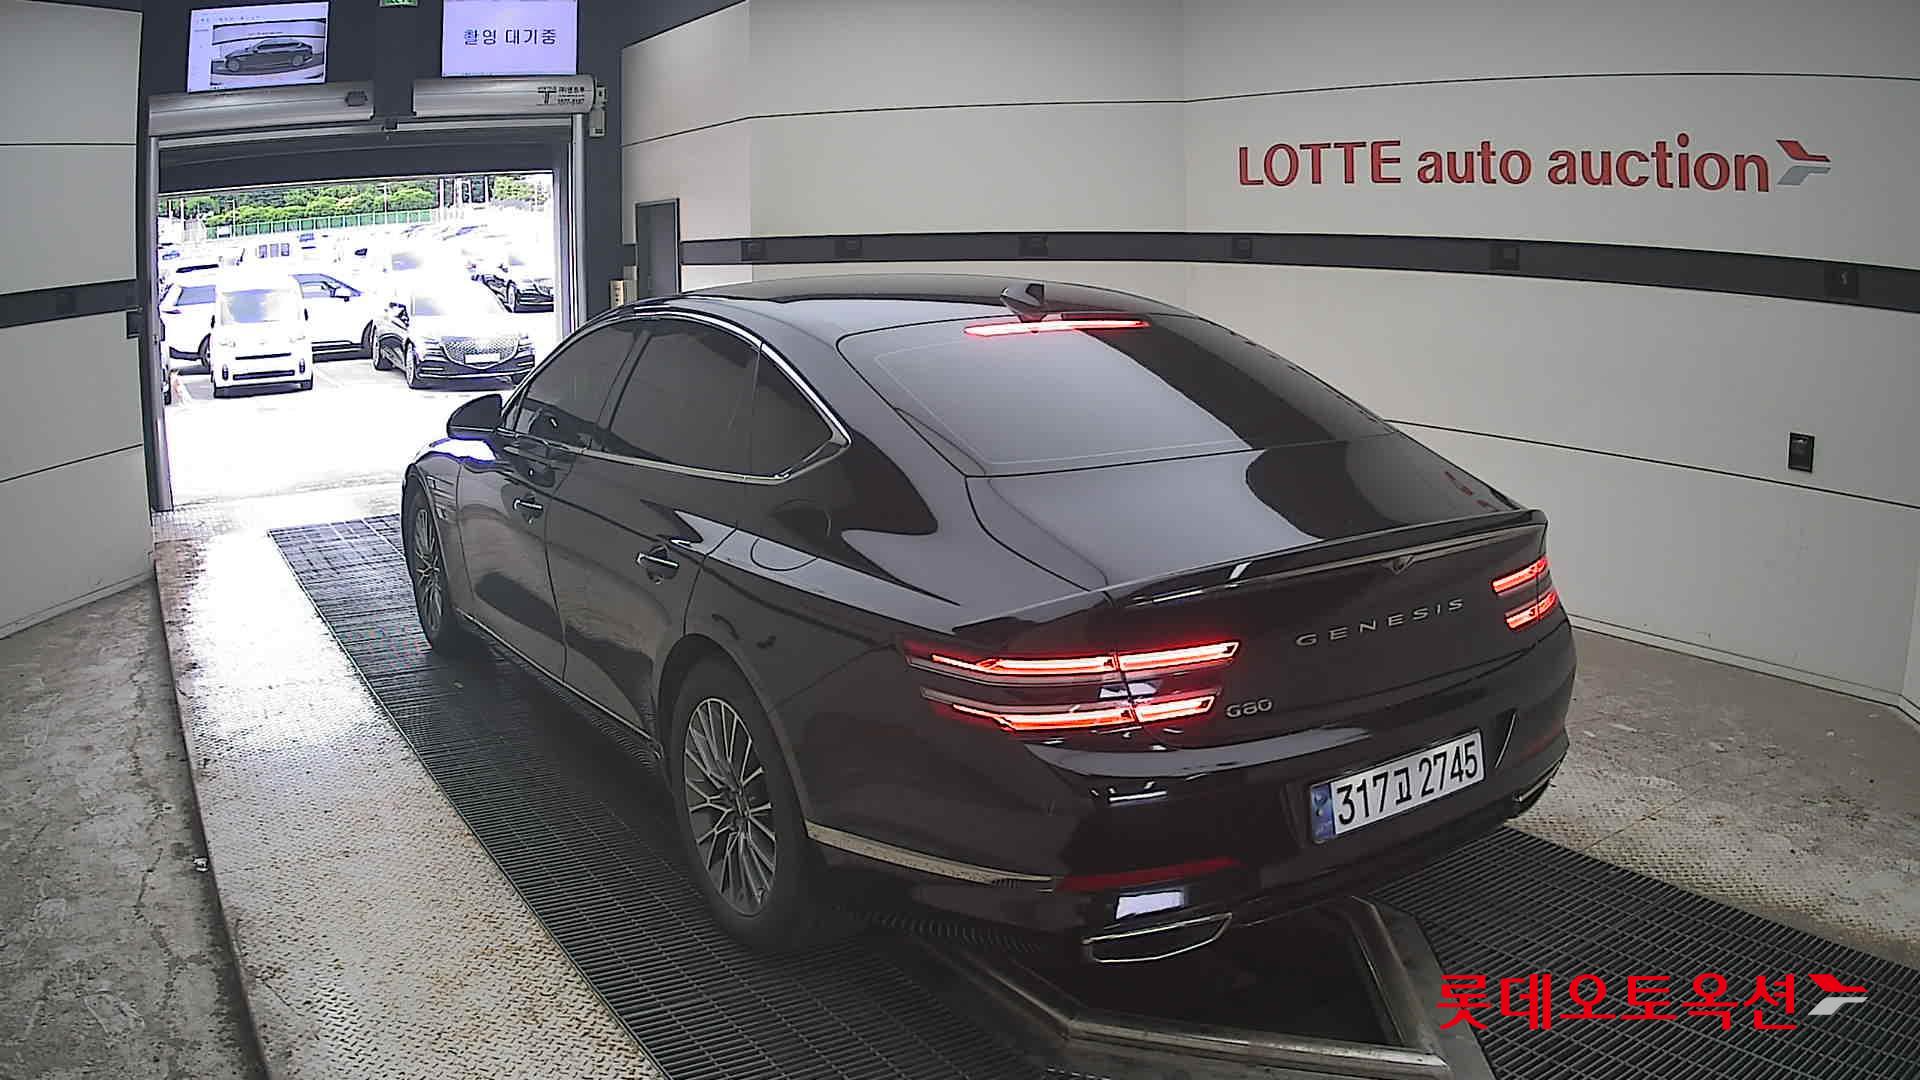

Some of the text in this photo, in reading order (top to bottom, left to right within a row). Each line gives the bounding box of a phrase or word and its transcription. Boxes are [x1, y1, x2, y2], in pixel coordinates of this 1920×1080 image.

[505, 29, 557, 45] 대기중
[1238, 132, 1770, 193] LOTTE auto auction
[1295, 598, 1465, 647] GENESIS
[1225, 698, 1273, 719] G80
[1418, 740, 1479, 798] 2745
